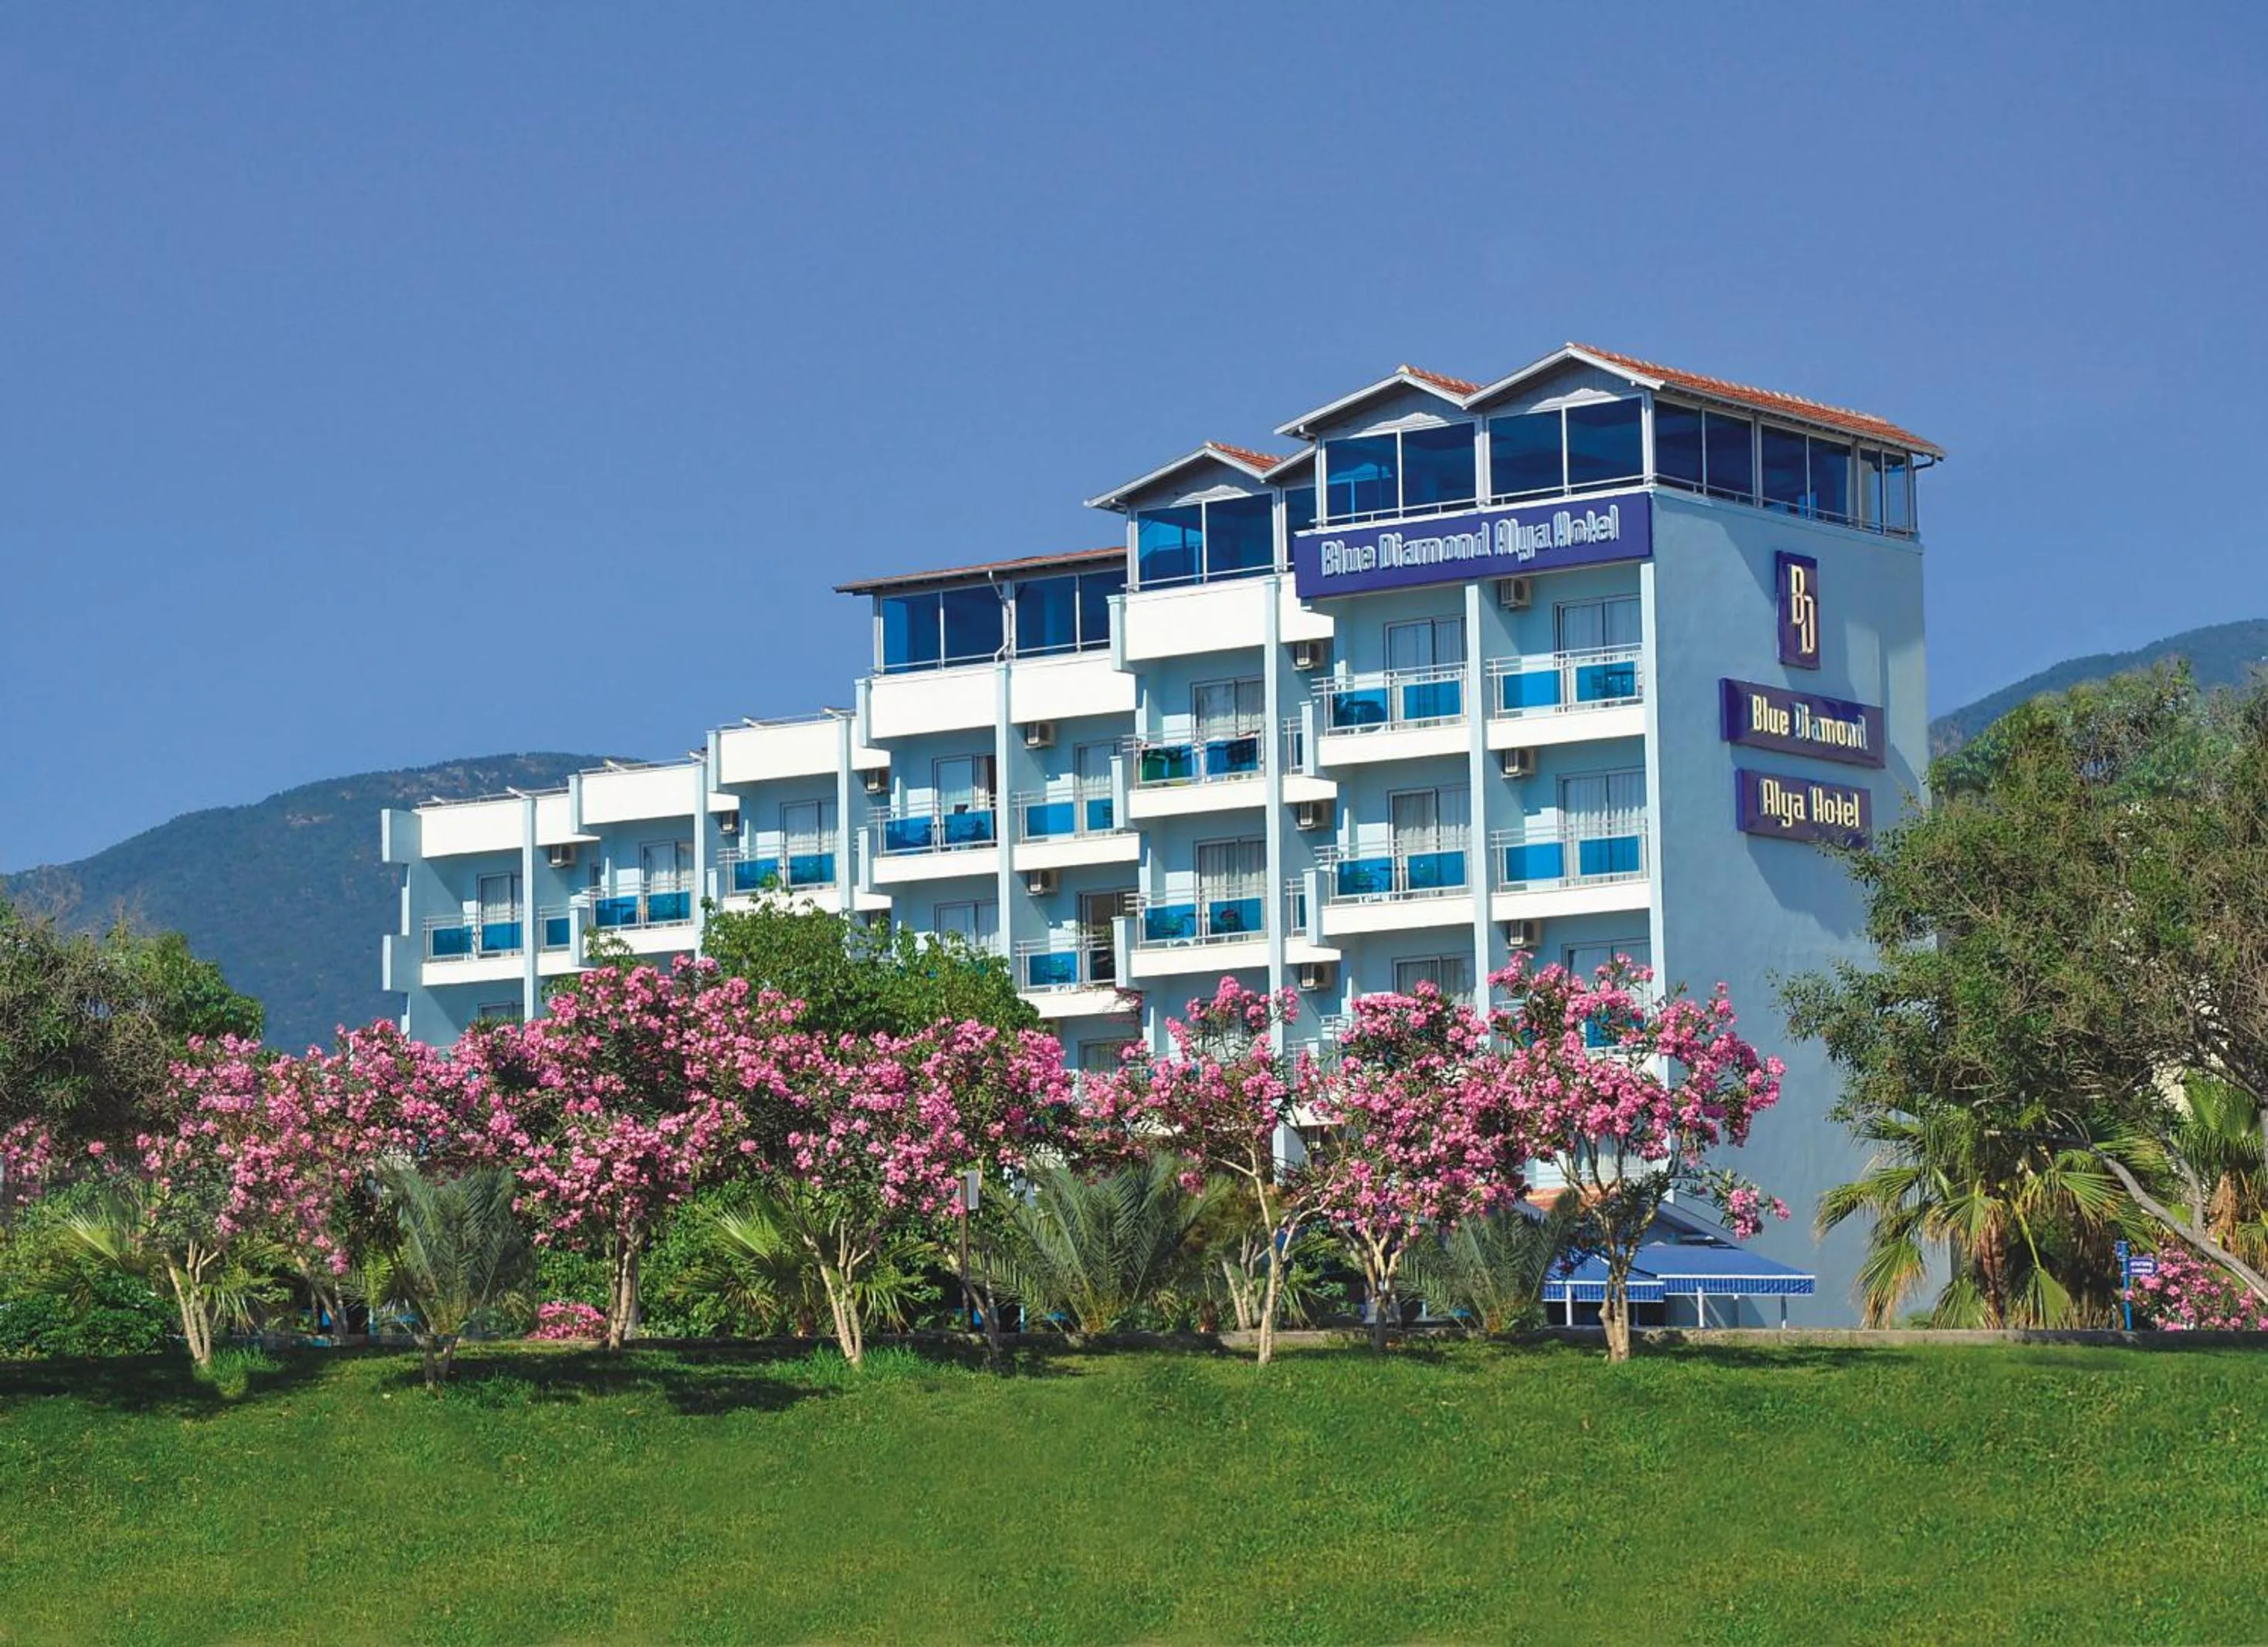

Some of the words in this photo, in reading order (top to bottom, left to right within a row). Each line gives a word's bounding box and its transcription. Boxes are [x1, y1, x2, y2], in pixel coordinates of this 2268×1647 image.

[1322, 541, 1376, 577] Blue
[1379, 524, 1491, 569] Diamond
[1495, 518, 1552, 562] Alya
[1553, 504, 1619, 547] Hotel
[1751, 695, 1789, 734] Blue
[1793, 702, 1867, 751] Diamond
[1760, 779, 1806, 829] Alya
[1809, 787, 1860, 828] Hotel
